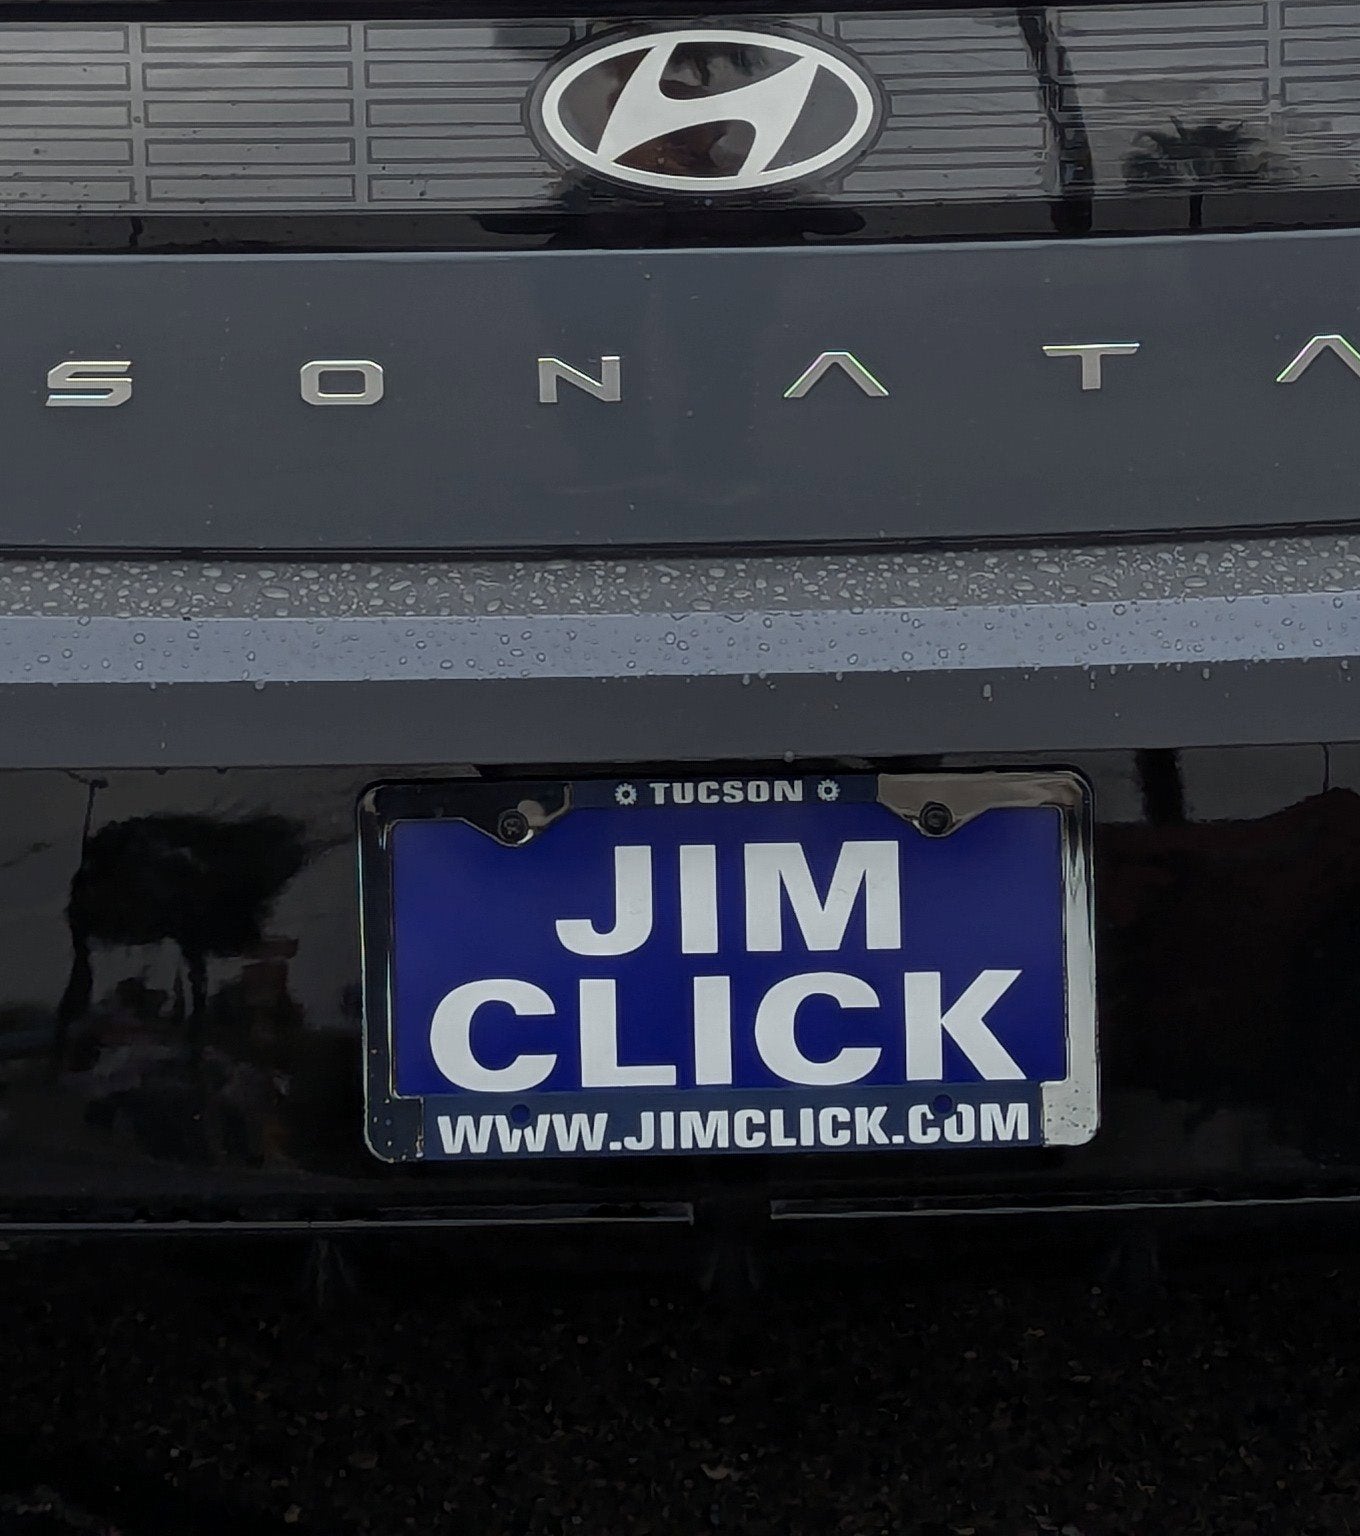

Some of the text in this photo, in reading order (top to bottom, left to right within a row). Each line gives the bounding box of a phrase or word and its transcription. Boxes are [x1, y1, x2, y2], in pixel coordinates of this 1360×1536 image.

[649, 778, 805, 805] TUCSON
[555, 839, 902, 957] JIM
[429, 969, 1028, 1093] CLICK
